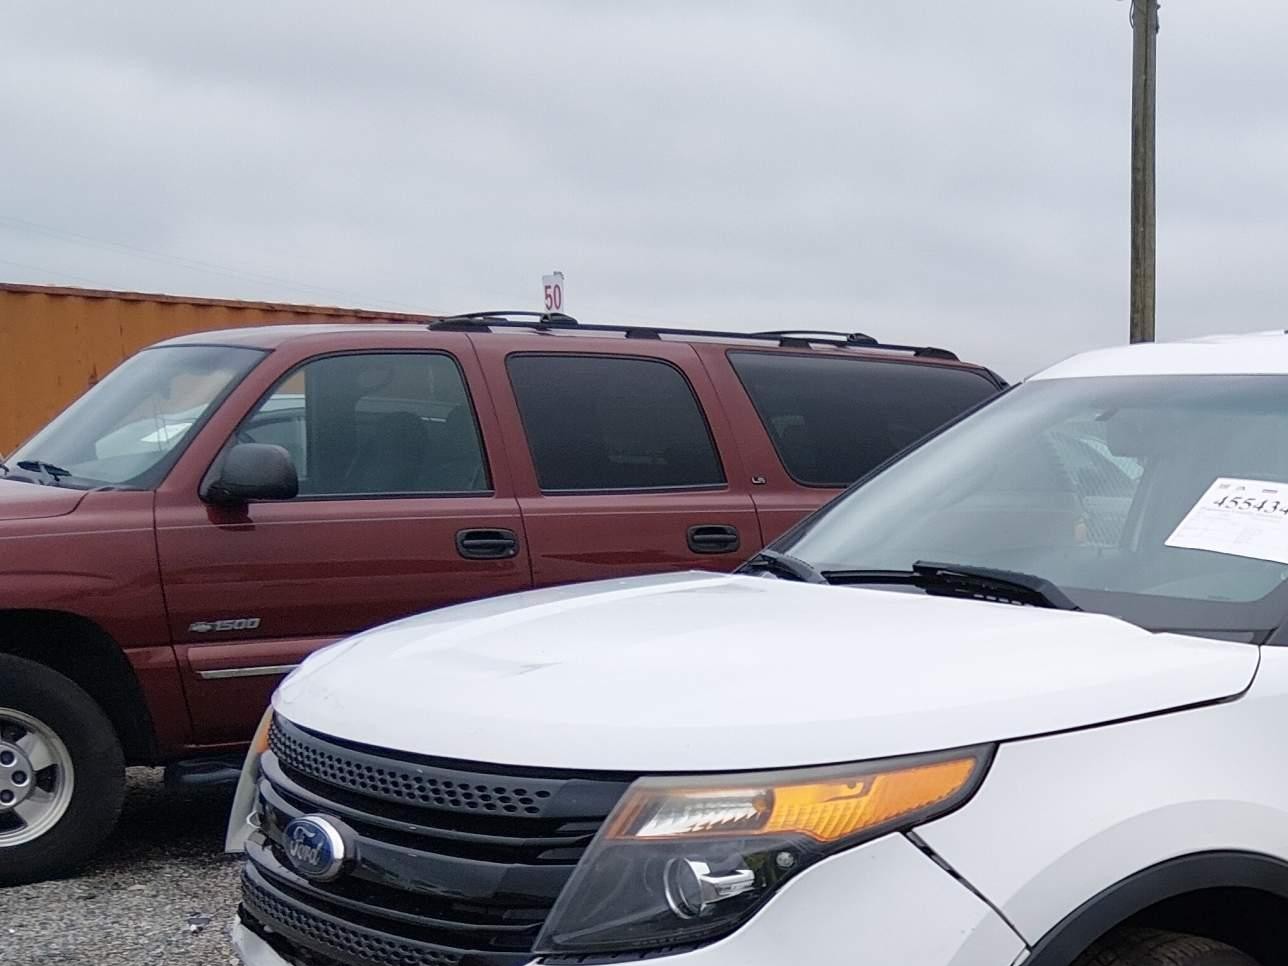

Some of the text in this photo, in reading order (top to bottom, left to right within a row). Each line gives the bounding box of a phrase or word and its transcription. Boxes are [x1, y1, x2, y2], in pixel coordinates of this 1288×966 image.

[544, 284, 562, 310] 50
[213, 618, 261, 631] 1500
[289, 826, 325, 866] Ford
